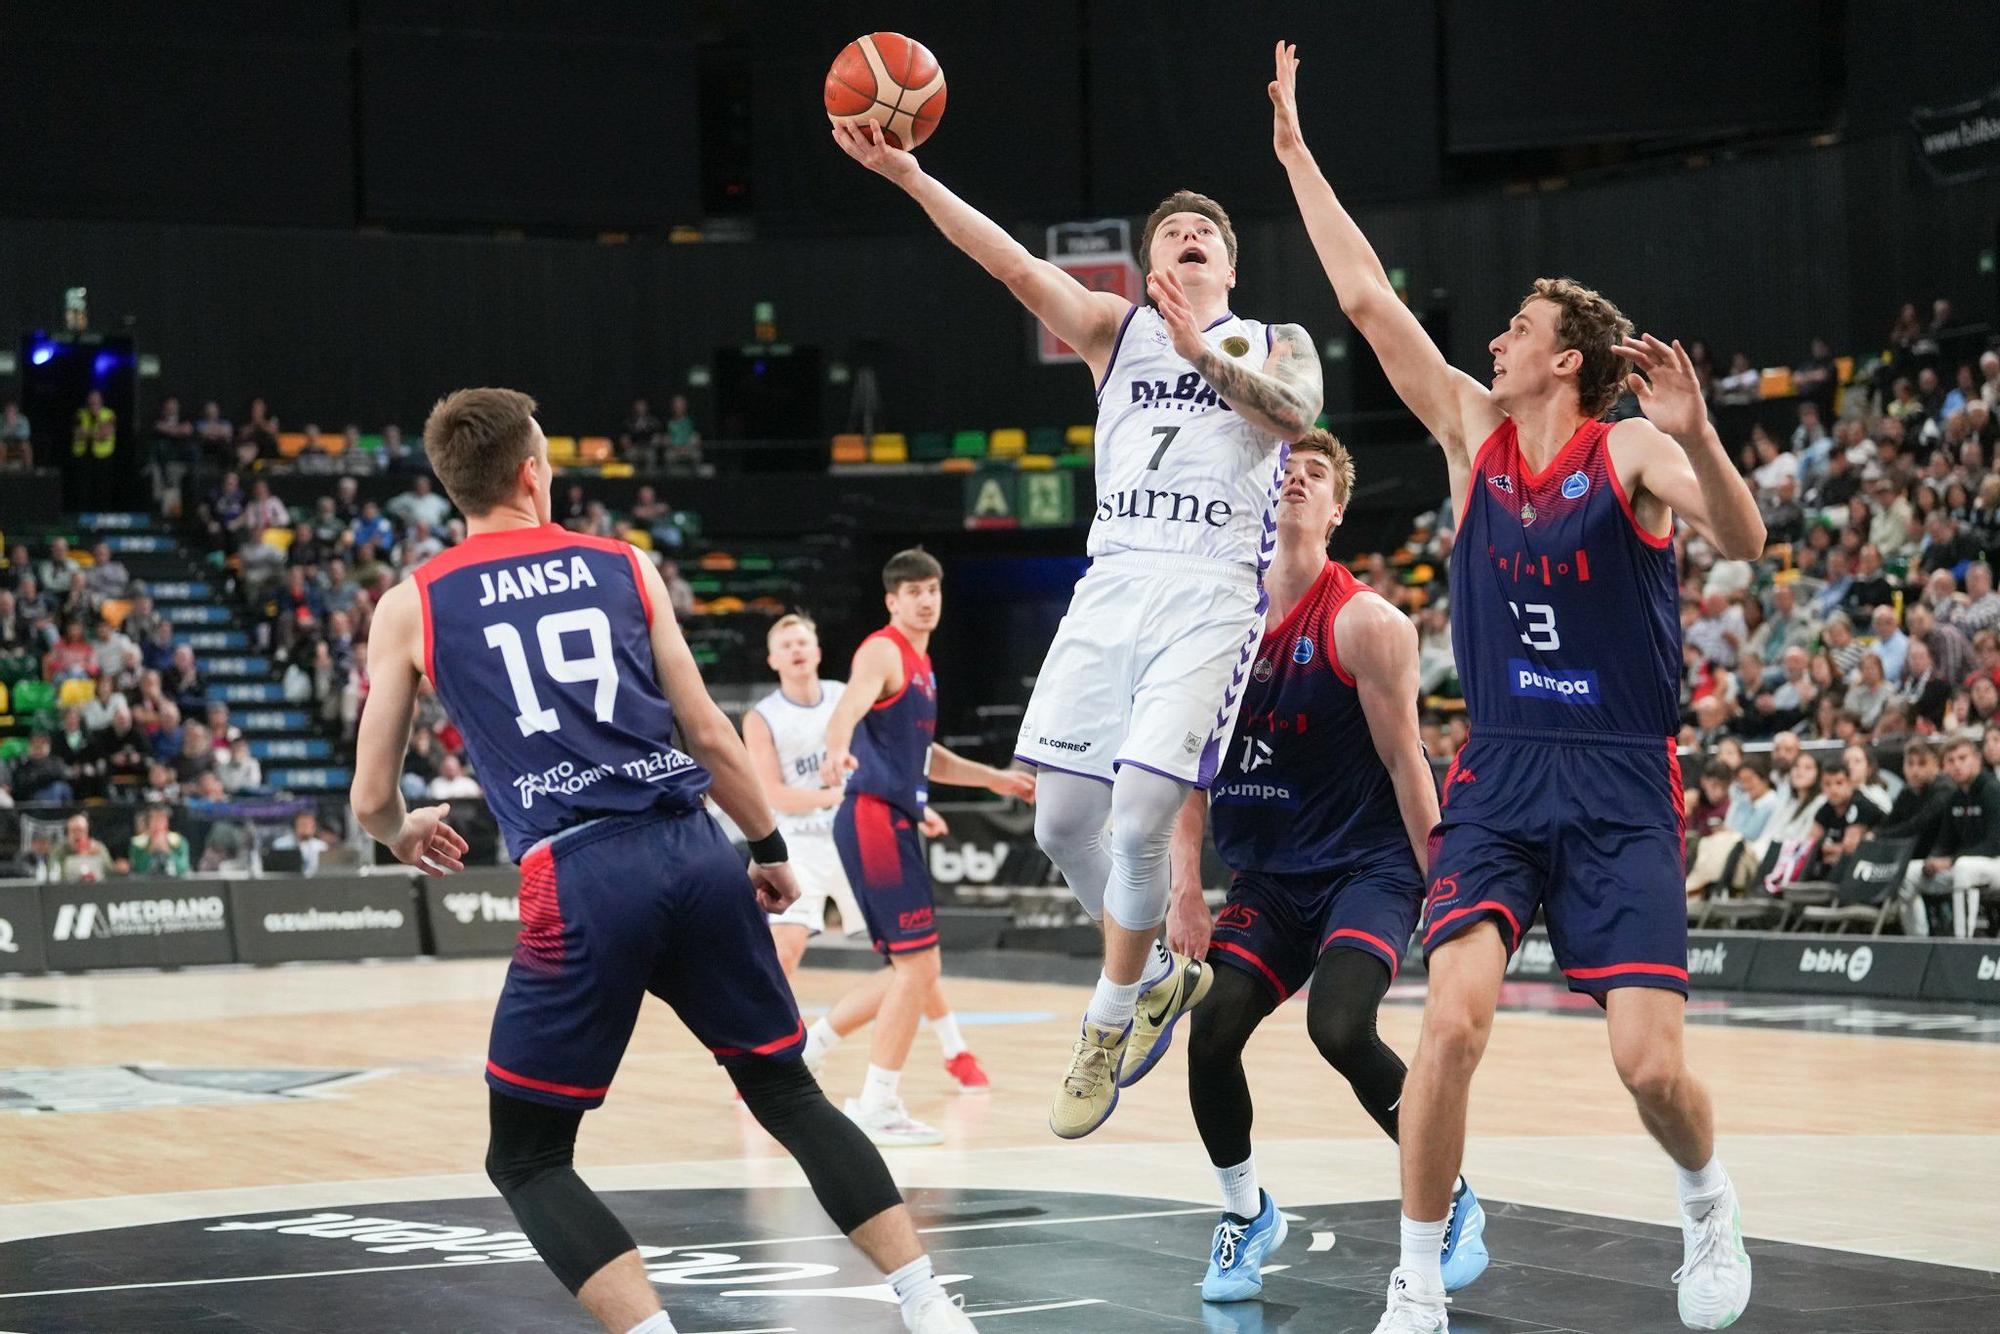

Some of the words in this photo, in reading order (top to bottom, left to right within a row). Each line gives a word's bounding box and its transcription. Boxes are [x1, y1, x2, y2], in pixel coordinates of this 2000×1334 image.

[1146, 426, 1181, 471] 7
[1097, 488, 1232, 527] surne
[479, 555, 597, 607] JANSA
[483, 607, 619, 737] 19
[1519, 670, 1589, 696] pumpa
[1039, 737, 1049, 746] EL
[1050, 739, 1087, 752] CORREO
[1799, 947, 1849, 973] bbk
